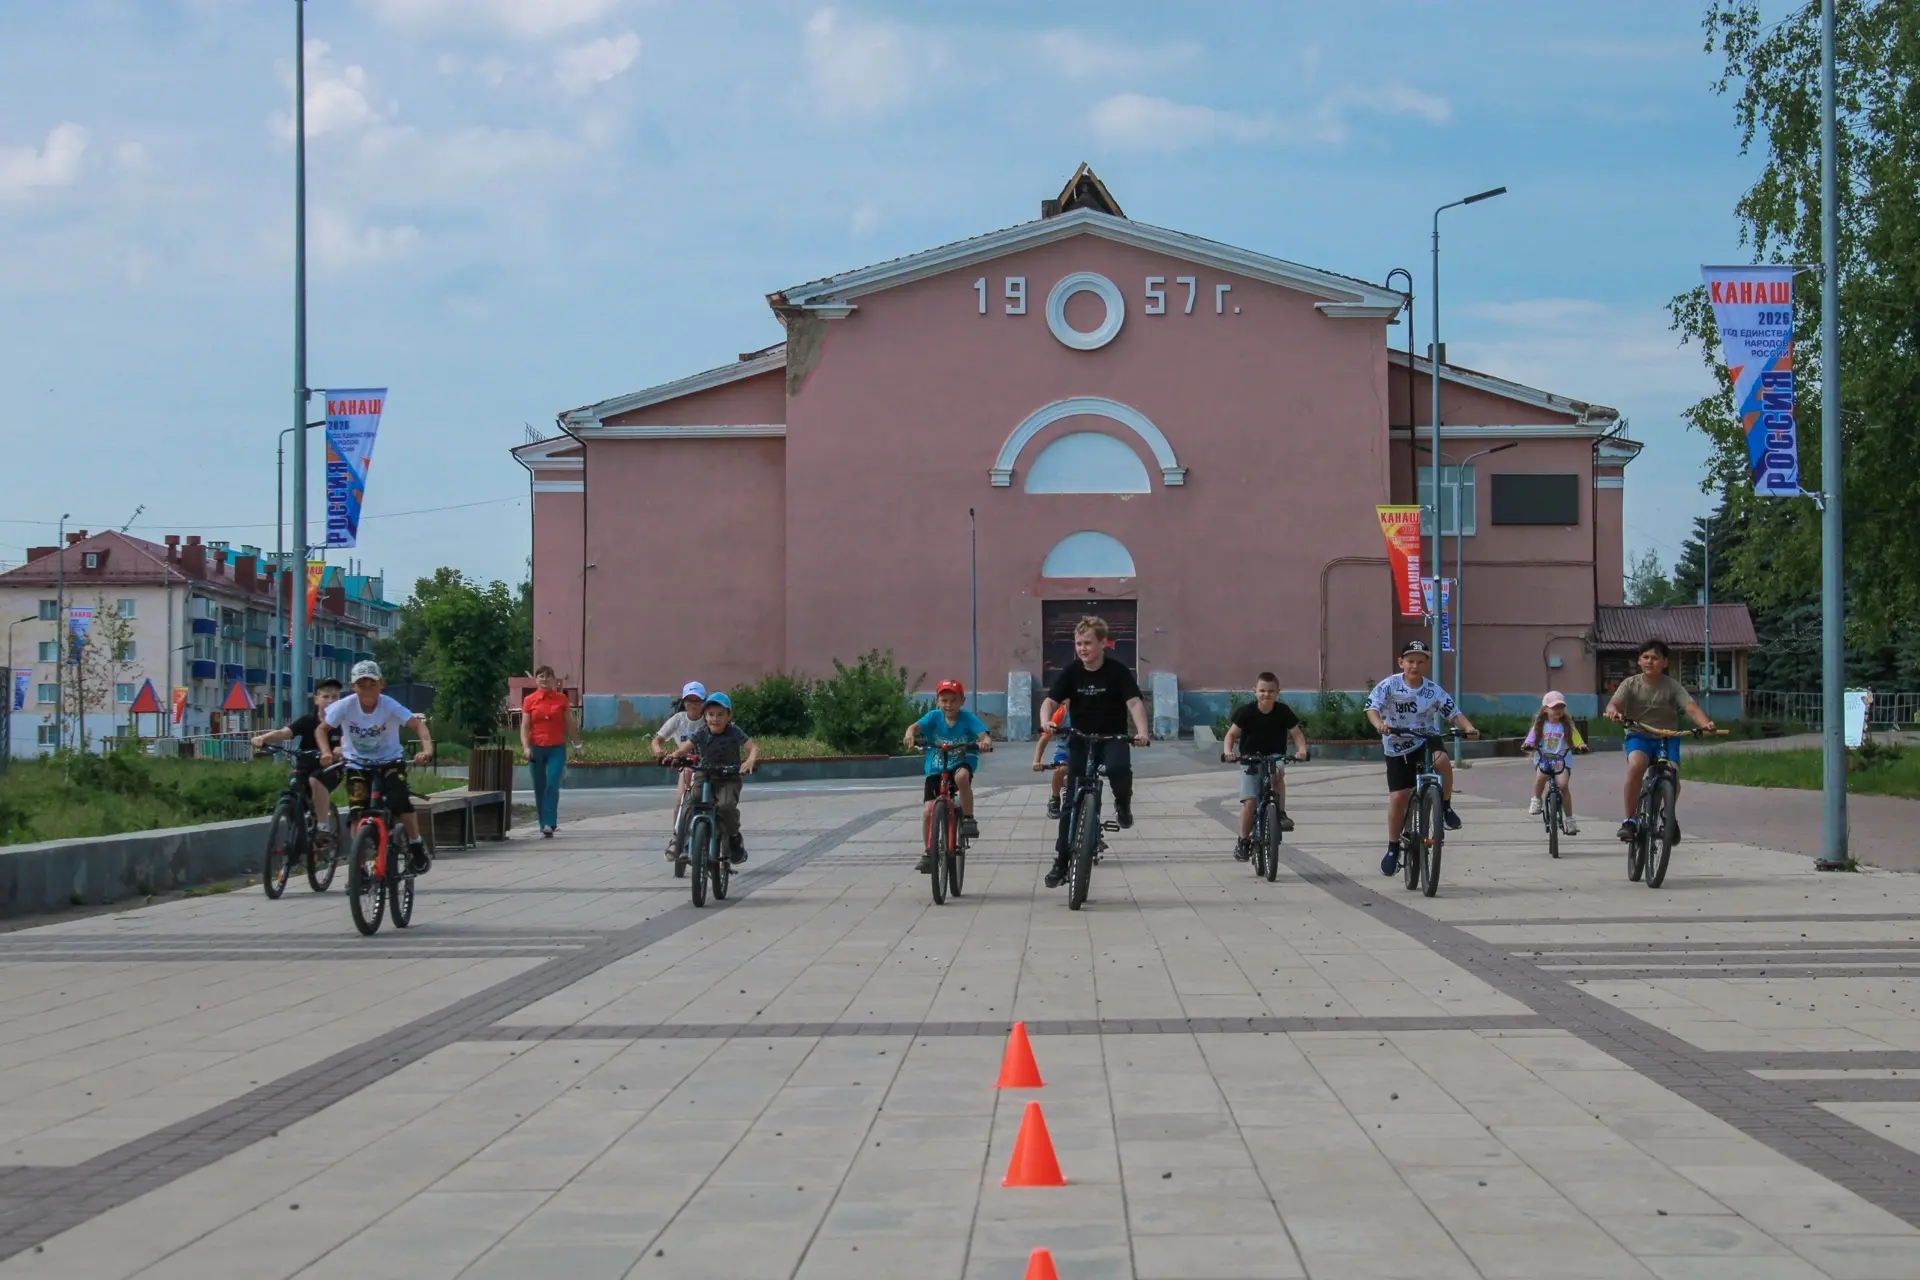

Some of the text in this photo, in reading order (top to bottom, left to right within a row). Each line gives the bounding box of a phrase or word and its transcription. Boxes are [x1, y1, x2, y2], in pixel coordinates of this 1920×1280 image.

[1711, 281, 1790, 305] КАНАШ
[1758, 312, 1790, 325] 2026
[1723, 328, 1789, 338] ГОД ЕДИНСТВА
[1745, 339, 1789, 348] НАРОДОВ
[1751, 349, 1789, 358] РОССИИ
[328, 399, 382, 415] КАНАШ
[328, 420, 350, 431] 2026
[1761, 370, 1797, 490] РОССИЯ
[327, 461, 349, 544] РОССИЯ
[1381, 512, 1419, 524] КАНАШ
[1407, 555, 1421, 612] ЧУВАШИЯ
